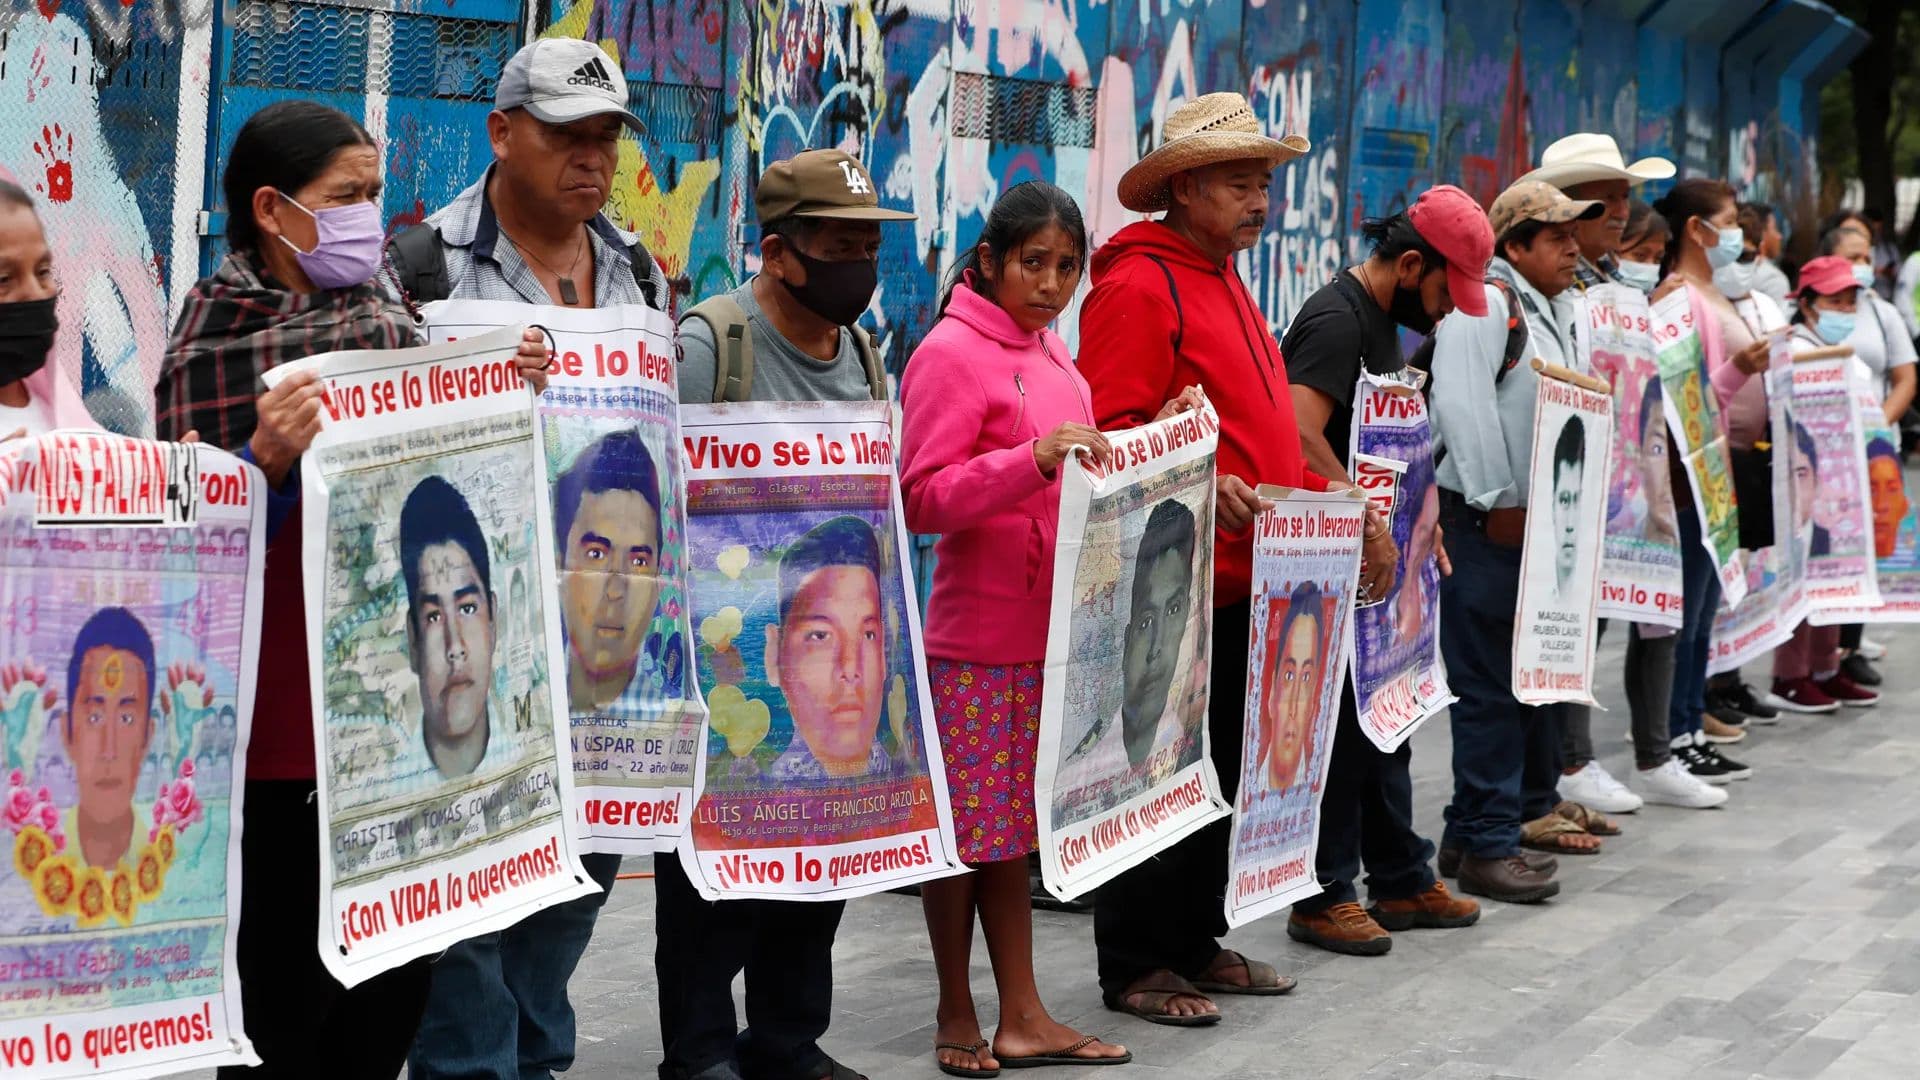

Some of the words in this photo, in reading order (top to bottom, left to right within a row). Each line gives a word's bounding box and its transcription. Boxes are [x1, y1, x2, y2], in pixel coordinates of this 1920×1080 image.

[567, 76, 617, 93] adidas
[838, 160, 870, 194] LA
[1284, 147, 1340, 238] LAS
[595, 343, 629, 378] lo
[371, 379, 396, 415] se
[402, 370, 422, 410] lo
[683, 436, 762, 470] Vivo
[773, 440, 811, 467] se
[817, 433, 846, 465] lo
[1127, 438, 1148, 467] se
[1145, 429, 1164, 460] lo
[38, 436, 84, 515] NOS
[90, 437, 167, 514] FALTAN
[701, 486, 719, 497] Jan
[1257, 509, 1289, 546] ¡Vivo
[1291, 515, 1303, 538] se
[1305, 510, 1315, 538] lo
[1602, 580, 1625, 602] ivo
[1630, 583, 1647, 605] lo
[645, 739, 663, 755] DE
[630, 761, 644, 773] 22
[698, 803, 741, 825] LUÍS
[754, 801, 812, 822] ÁNGEL
[824, 795, 886, 819] FRANCISCO
[890, 788, 928, 809] ARZOLA
[1058, 835, 1092, 875] ¡Con
[1091, 813, 1127, 854] VIDA
[1125, 808, 1141, 838] lo
[1138, 772, 1207, 833] queremos!
[335, 815, 413, 854] CHRISTIAN
[423, 802, 462, 831] TOMÁS
[721, 827, 742, 837] Hijo
[746, 827, 758, 835] de
[761, 825, 799, 834] Lorenzo
[803, 826, 809, 835] y
[715, 853, 785, 889] ¡Vivo
[795, 851, 822, 882] lo
[829, 835, 933, 887] queremos!
[1258, 866, 1266, 891] lo
[1266, 850, 1307, 894] queremos!
[341, 900, 387, 950] ¡Con
[390, 878, 441, 927] VIDA
[446, 872, 463, 911] lo
[467, 836, 563, 908] queremos!
[0, 952, 65, 982] arcial
[0, 1035, 34, 1068] vo
[45, 1023, 72, 1064] lo
[83, 1002, 213, 1069] queremos!
